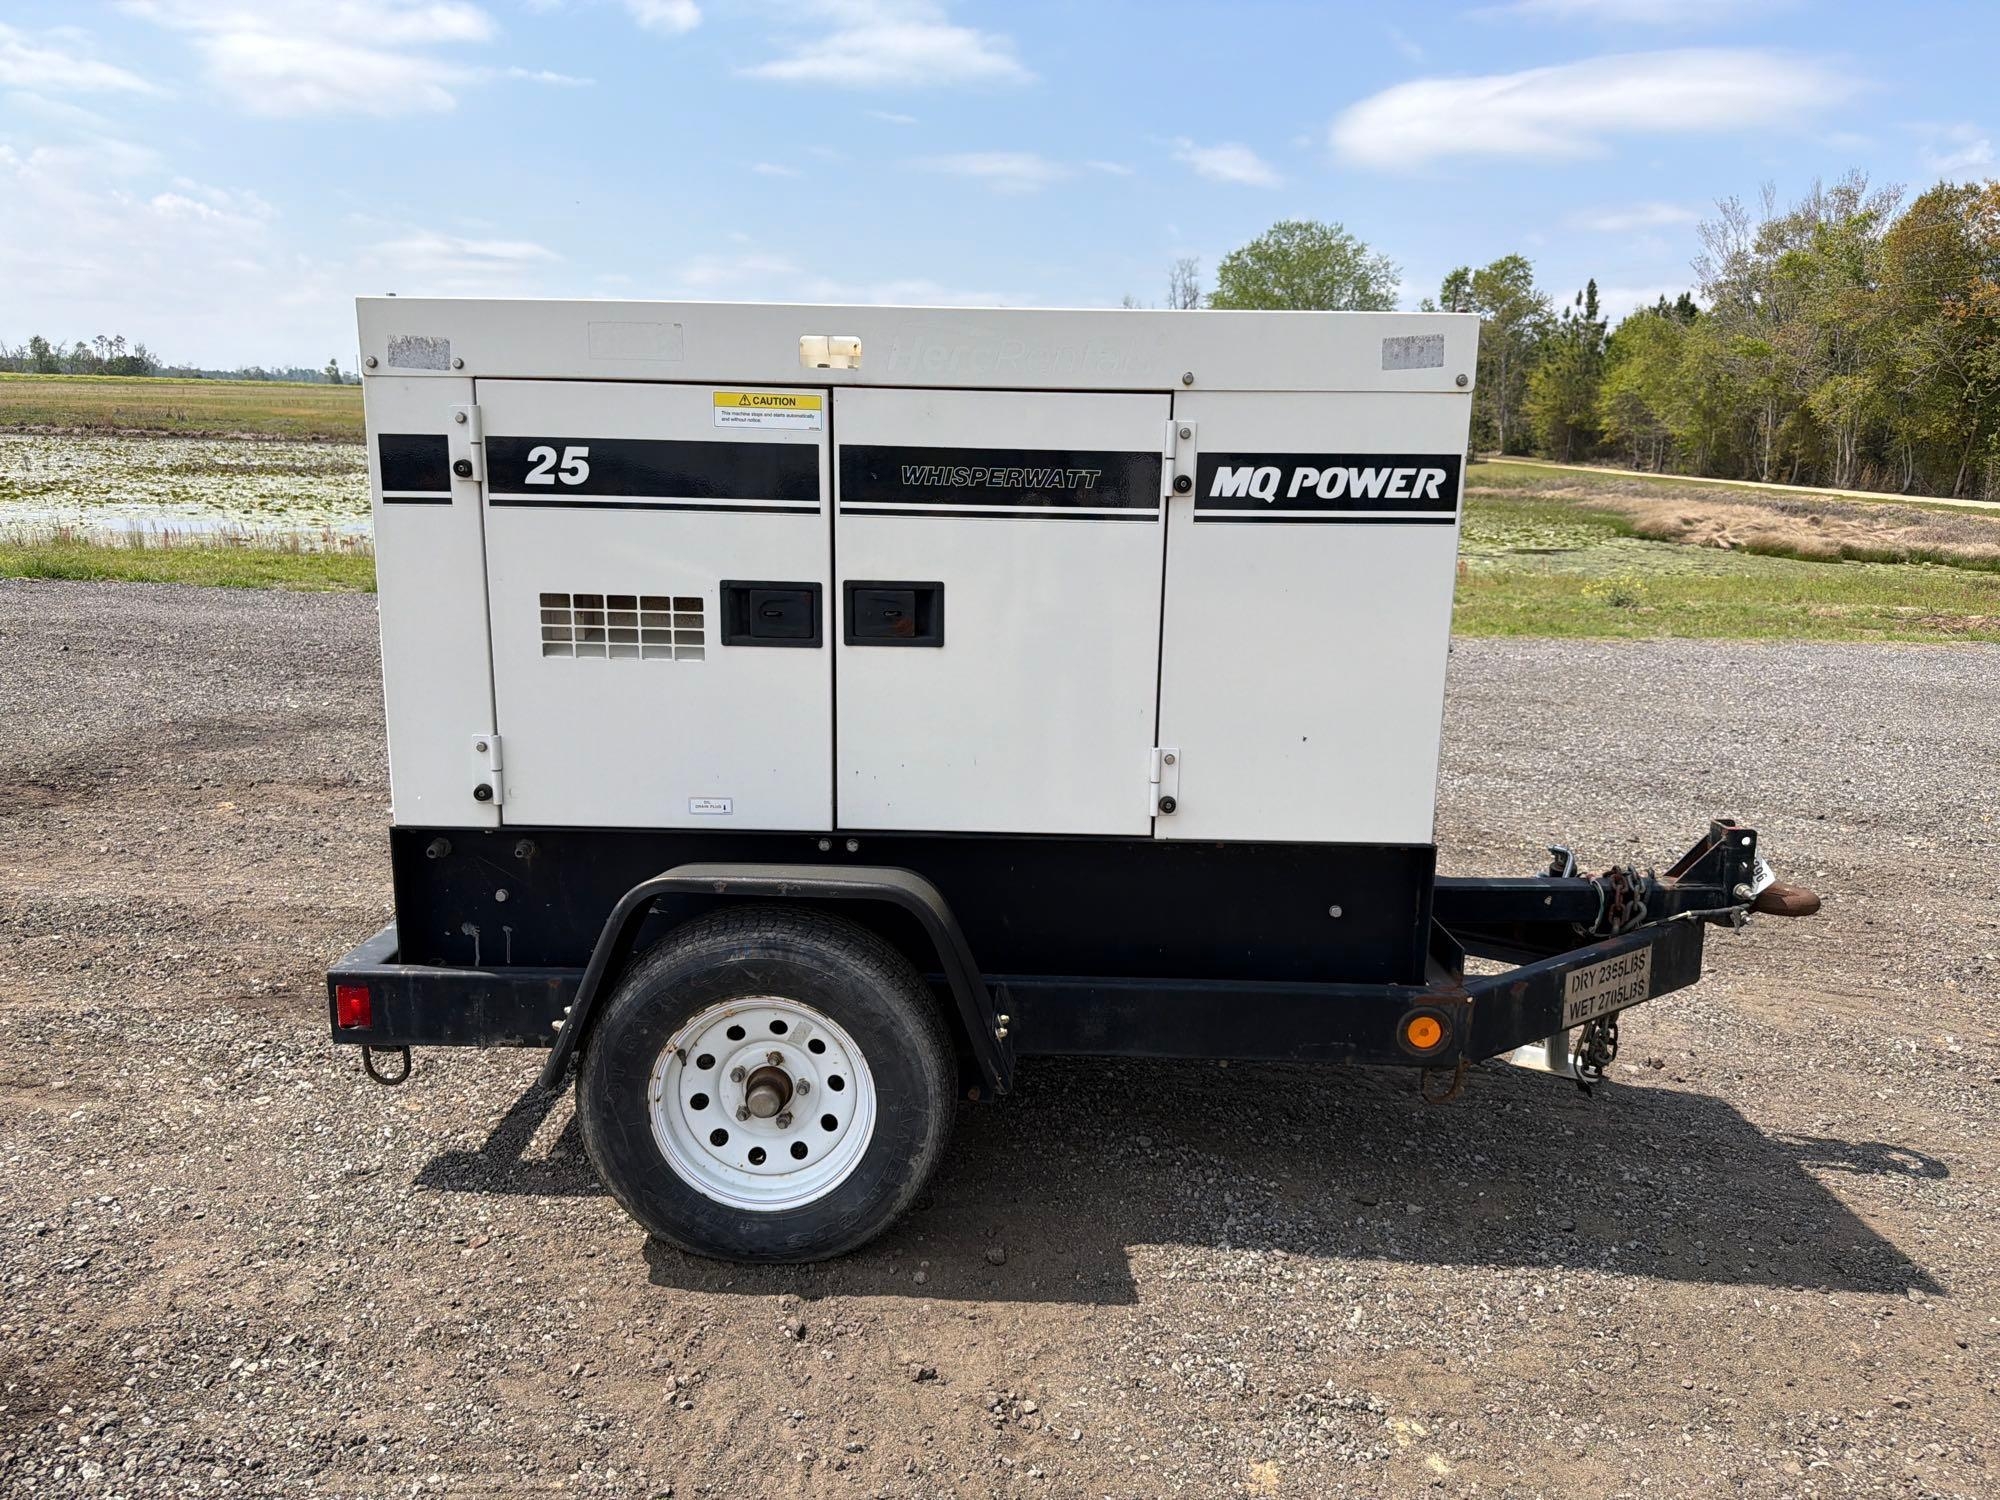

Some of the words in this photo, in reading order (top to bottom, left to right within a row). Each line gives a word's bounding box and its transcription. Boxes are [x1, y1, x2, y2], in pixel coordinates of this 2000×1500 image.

[752, 396, 796, 406] CAUTION
[525, 446, 590, 486] 25
[901, 466, 1101, 488] WHISPERWATT
[1209, 466, 1282, 503] MQ
[1286, 467, 1447, 499] POWER
[1571, 968, 1597, 994] DRY
[1569, 996, 1596, 1020] WET
[1597, 979, 1645, 1011] 2705LBS
